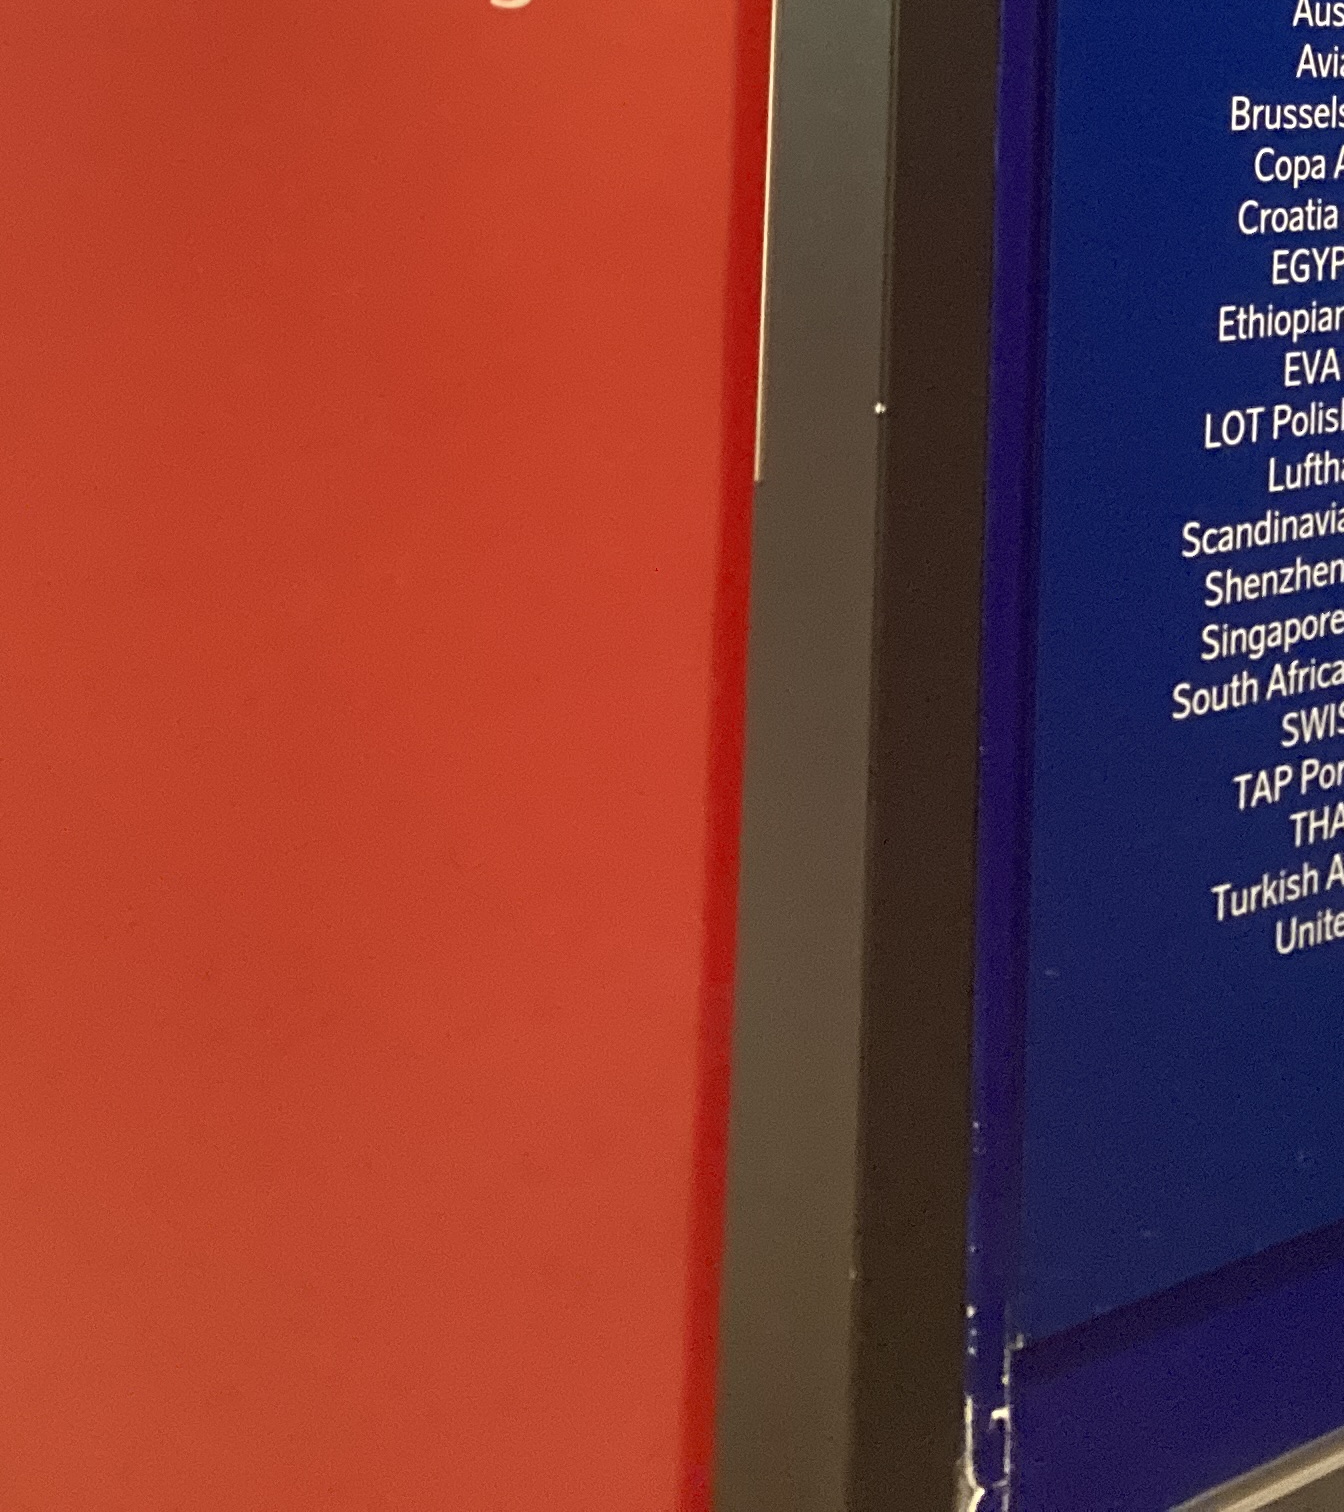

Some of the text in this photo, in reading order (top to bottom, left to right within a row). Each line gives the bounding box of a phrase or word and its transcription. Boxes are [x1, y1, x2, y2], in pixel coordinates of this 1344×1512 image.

[1254, 147, 1325, 188] Copa
[1238, 199, 1338, 235] Croatia
[1284, 349, 1341, 387] EVA
[1205, 407, 1265, 449] LOT
[1204, 555, 1344, 607] Shenzhen
[1172, 670, 1258, 719] South
[1233, 765, 1293, 811] TAP
[1211, 863, 1318, 921] Turkish
